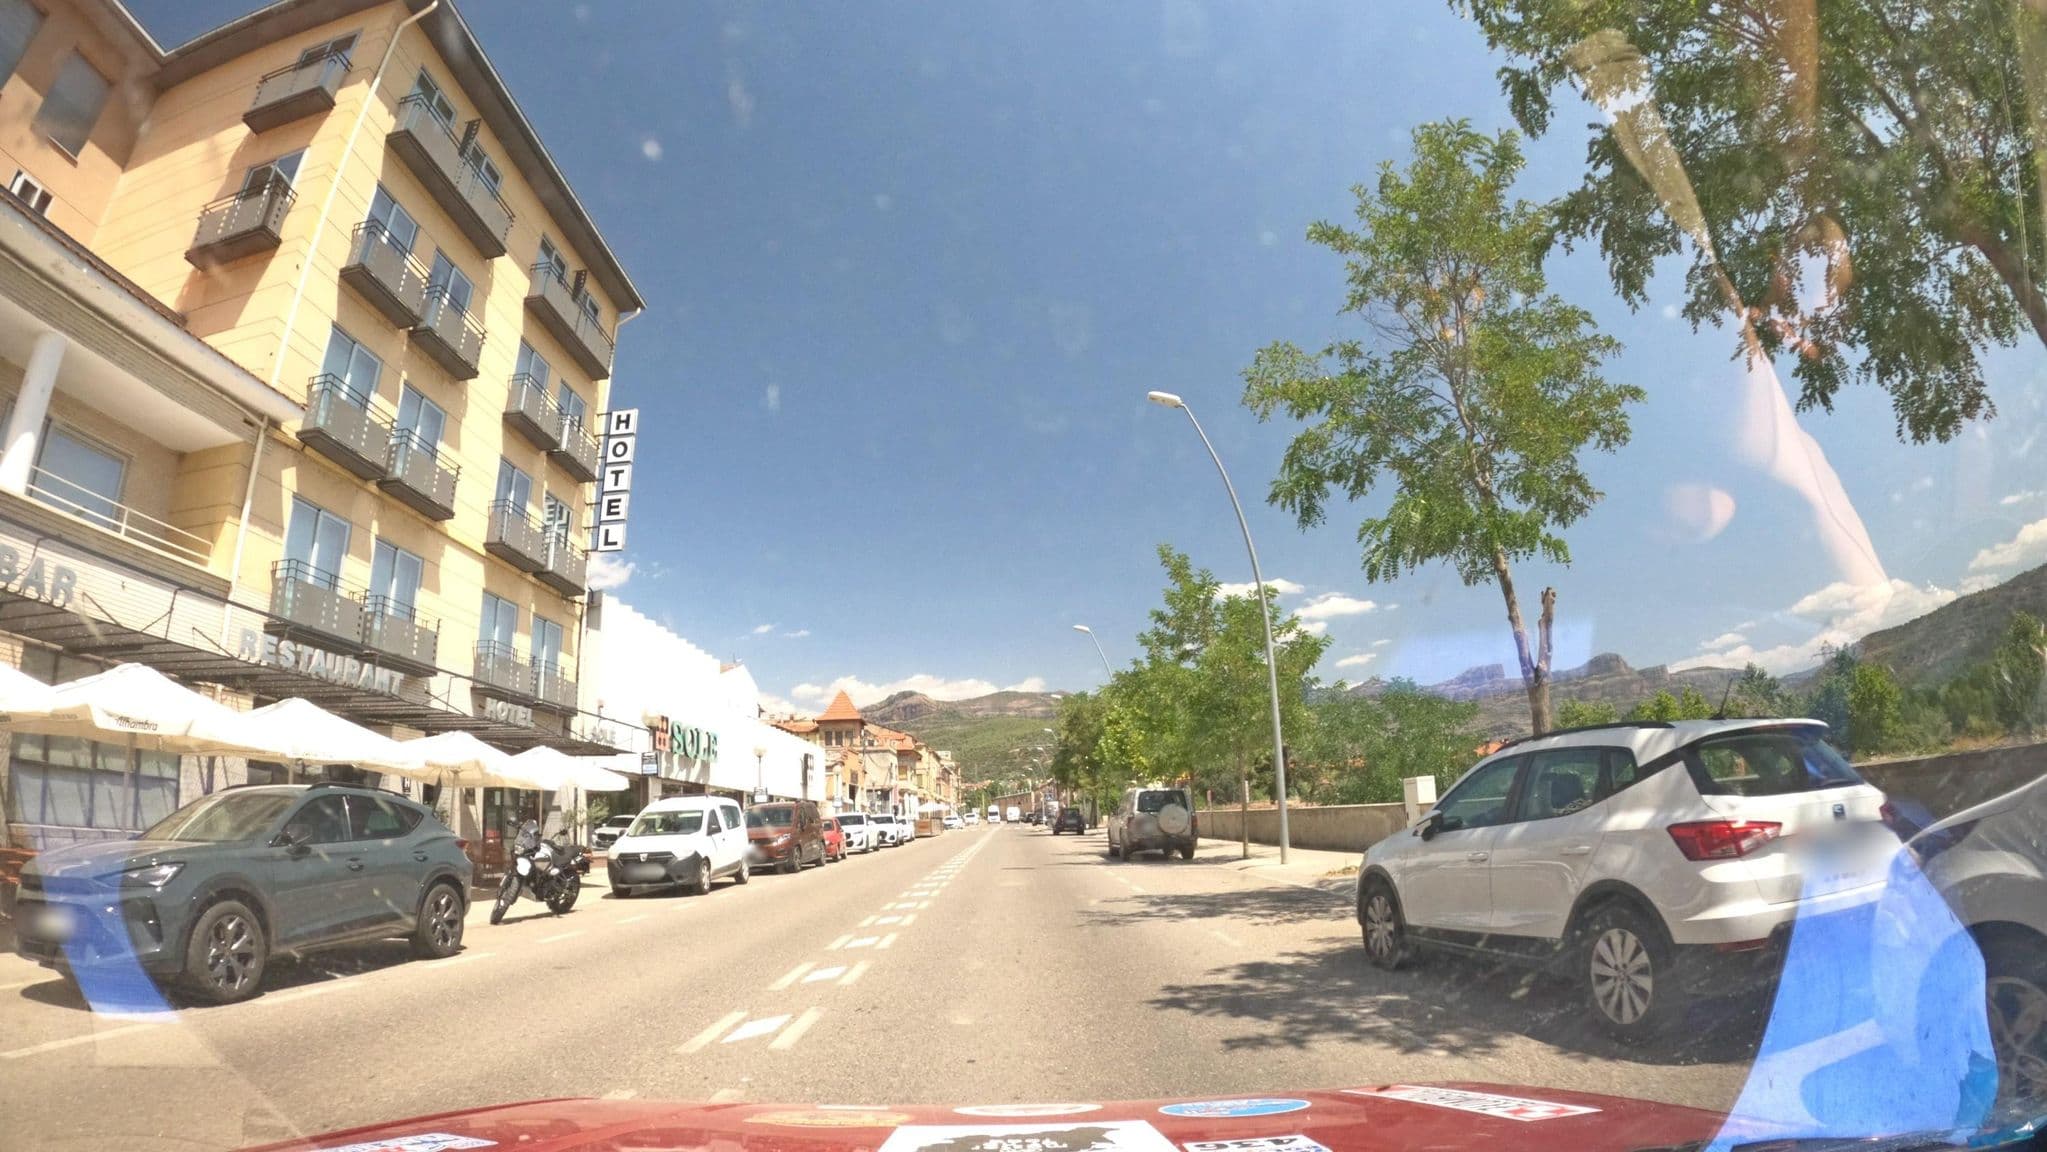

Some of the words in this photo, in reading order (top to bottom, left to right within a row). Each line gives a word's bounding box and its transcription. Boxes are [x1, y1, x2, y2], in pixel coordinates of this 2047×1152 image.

[603, 413, 631, 547] HOTEL
[0, 543, 77, 604] BAR
[239, 627, 404, 696] RESTAURANT
[485, 697, 535, 729] HOTEL
